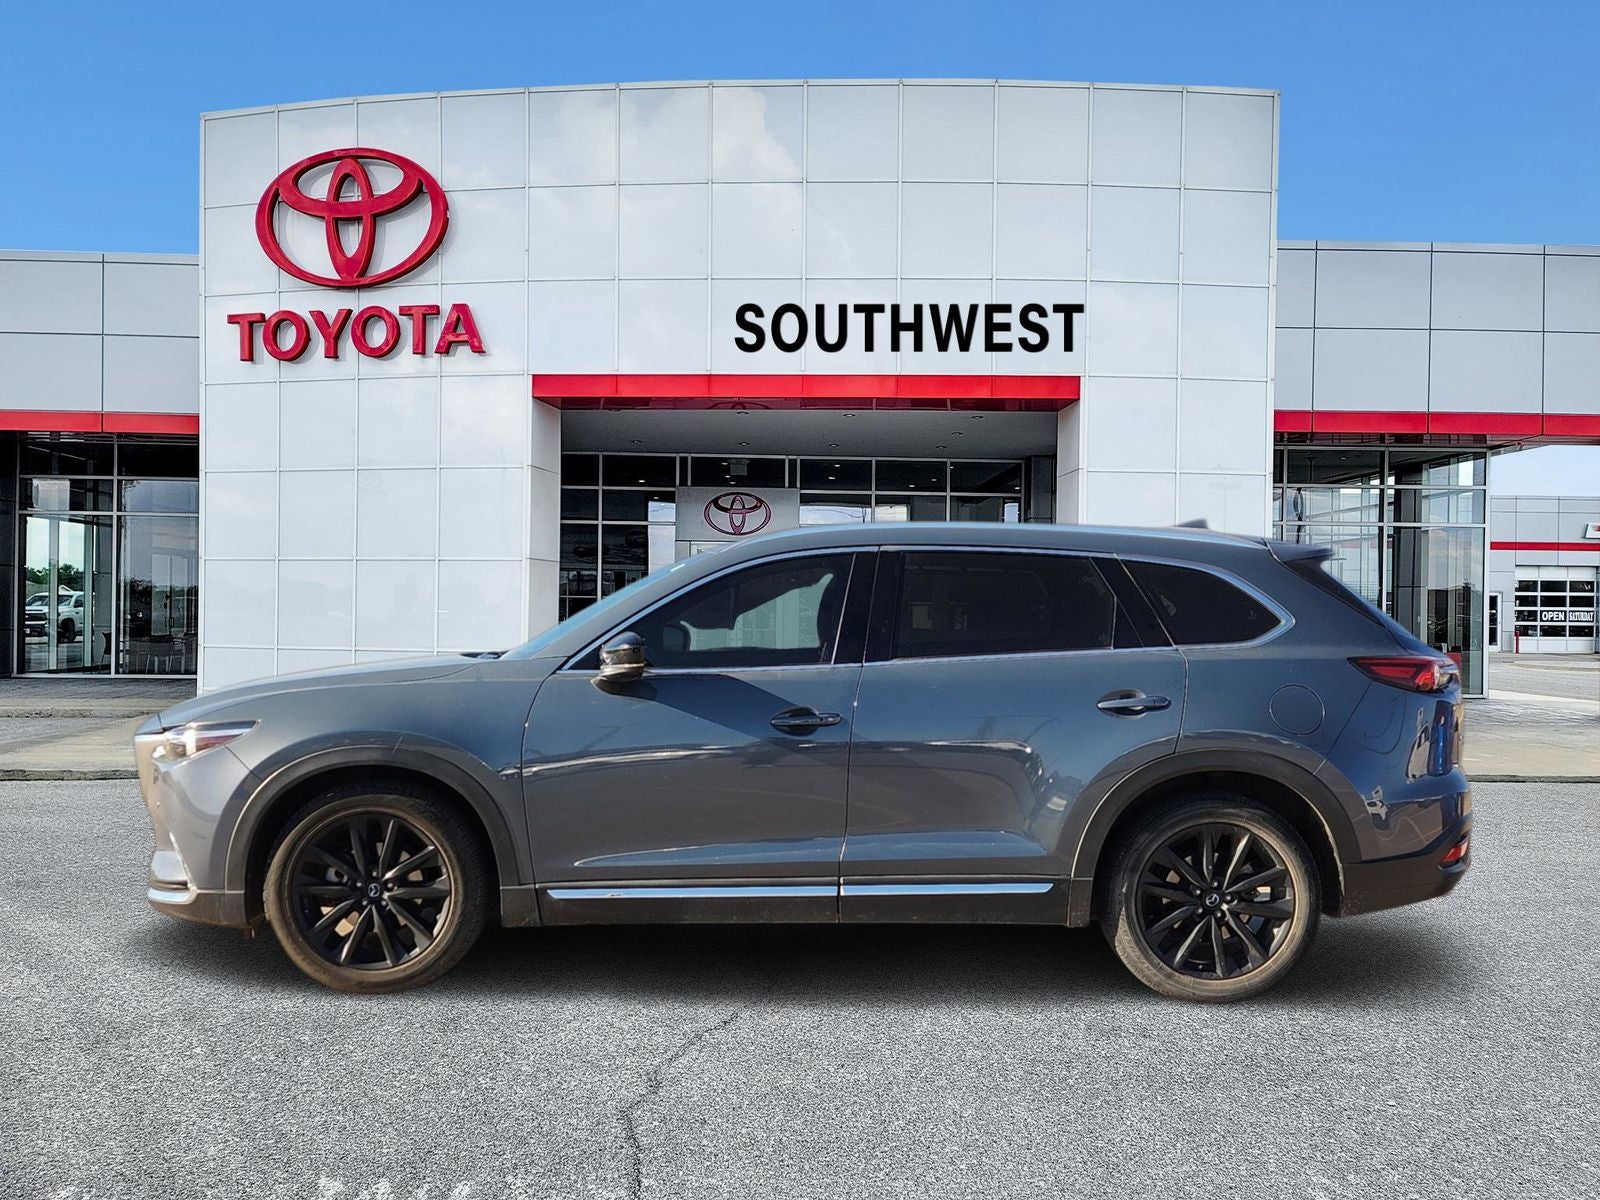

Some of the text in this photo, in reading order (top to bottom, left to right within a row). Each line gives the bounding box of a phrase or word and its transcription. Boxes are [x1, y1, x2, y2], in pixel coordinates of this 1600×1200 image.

[227, 303, 486, 362] TOYOTA
[734, 303, 1085, 353] SOUTHWEST
[1541, 611, 1565, 621] OPEN
